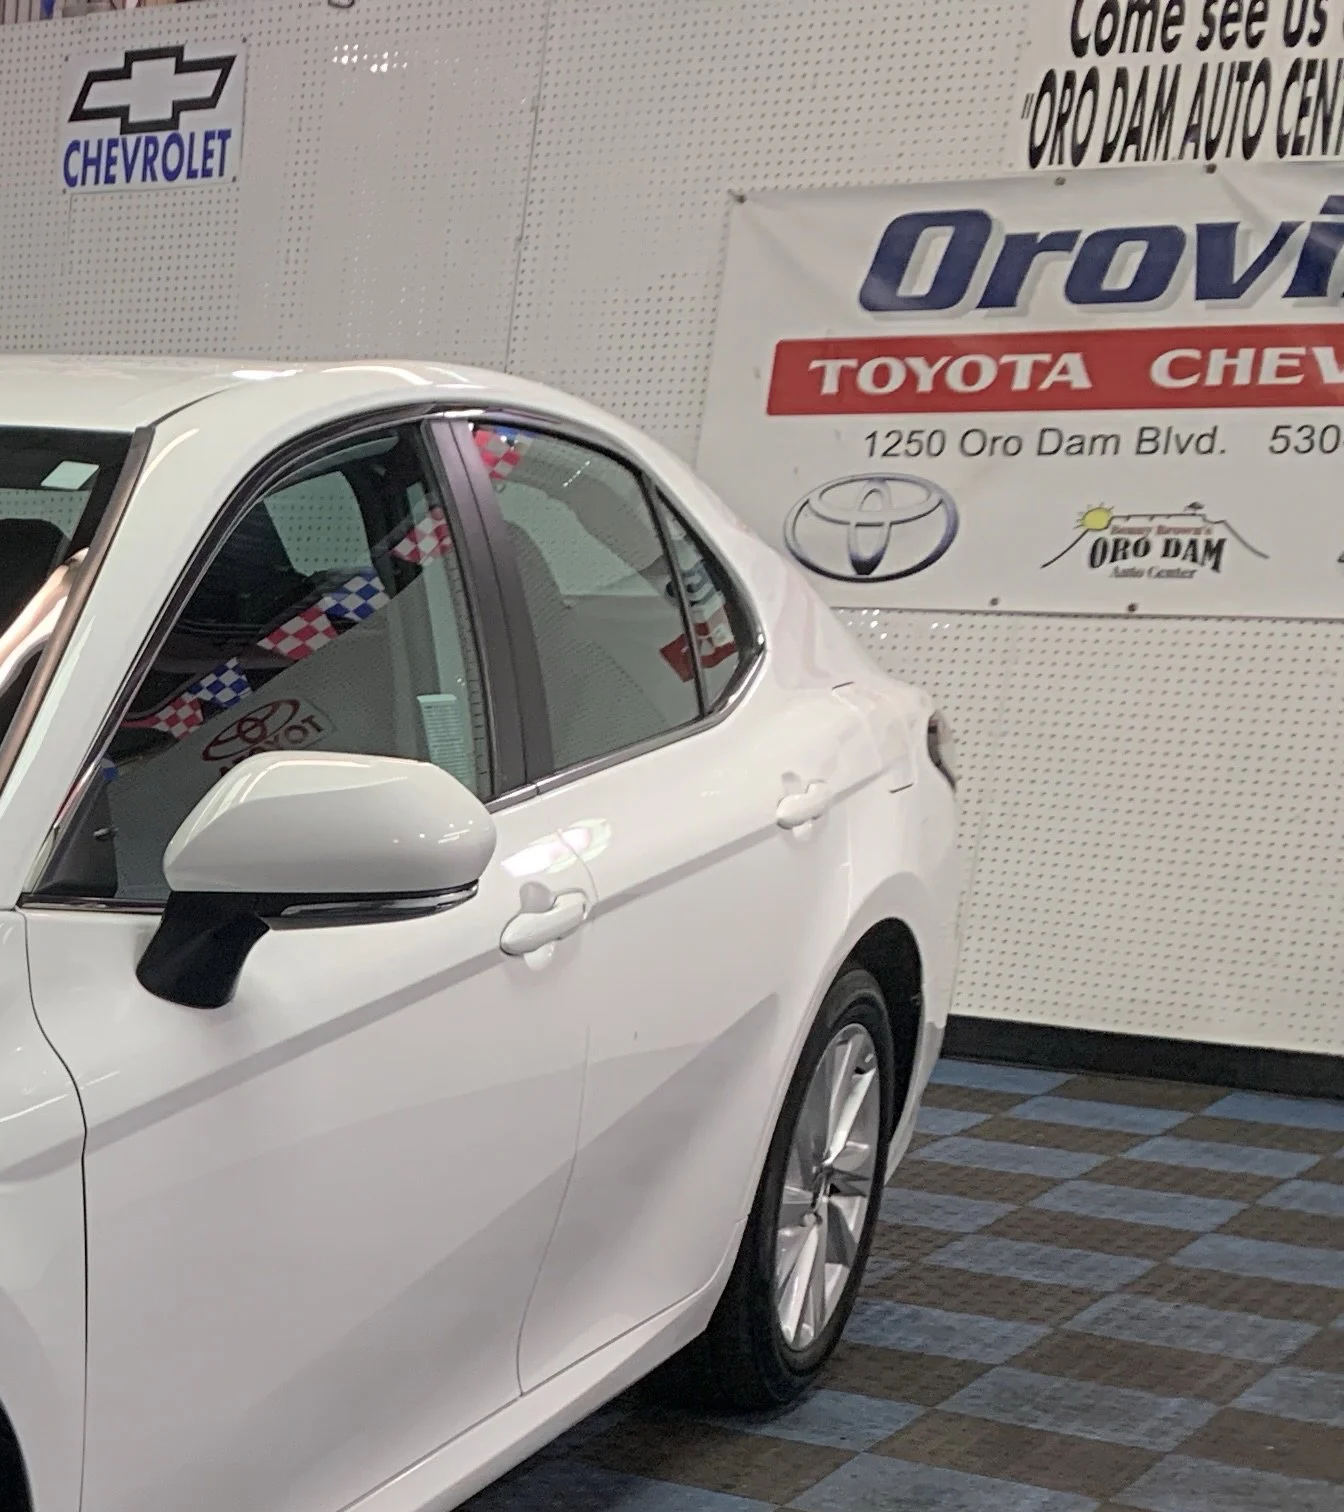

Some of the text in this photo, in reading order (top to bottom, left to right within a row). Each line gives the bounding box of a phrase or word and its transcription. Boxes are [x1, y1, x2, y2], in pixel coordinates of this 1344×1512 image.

[1070, 0, 1187, 58] Come
[1196, 0, 1269, 50] see
[1283, 0, 1329, 48] us
[1020, 57, 1344, 170] "ORO DAM AUTO CEN
[63, 128, 232, 188] CHEVROLET
[858, 194, 1344, 312] Orovi
[808, 351, 1093, 396] TOYOTA
[864, 424, 1344, 459] 1250 Oro Dam Blvd. 530
[1088, 536, 1227, 573] ORO DAM
